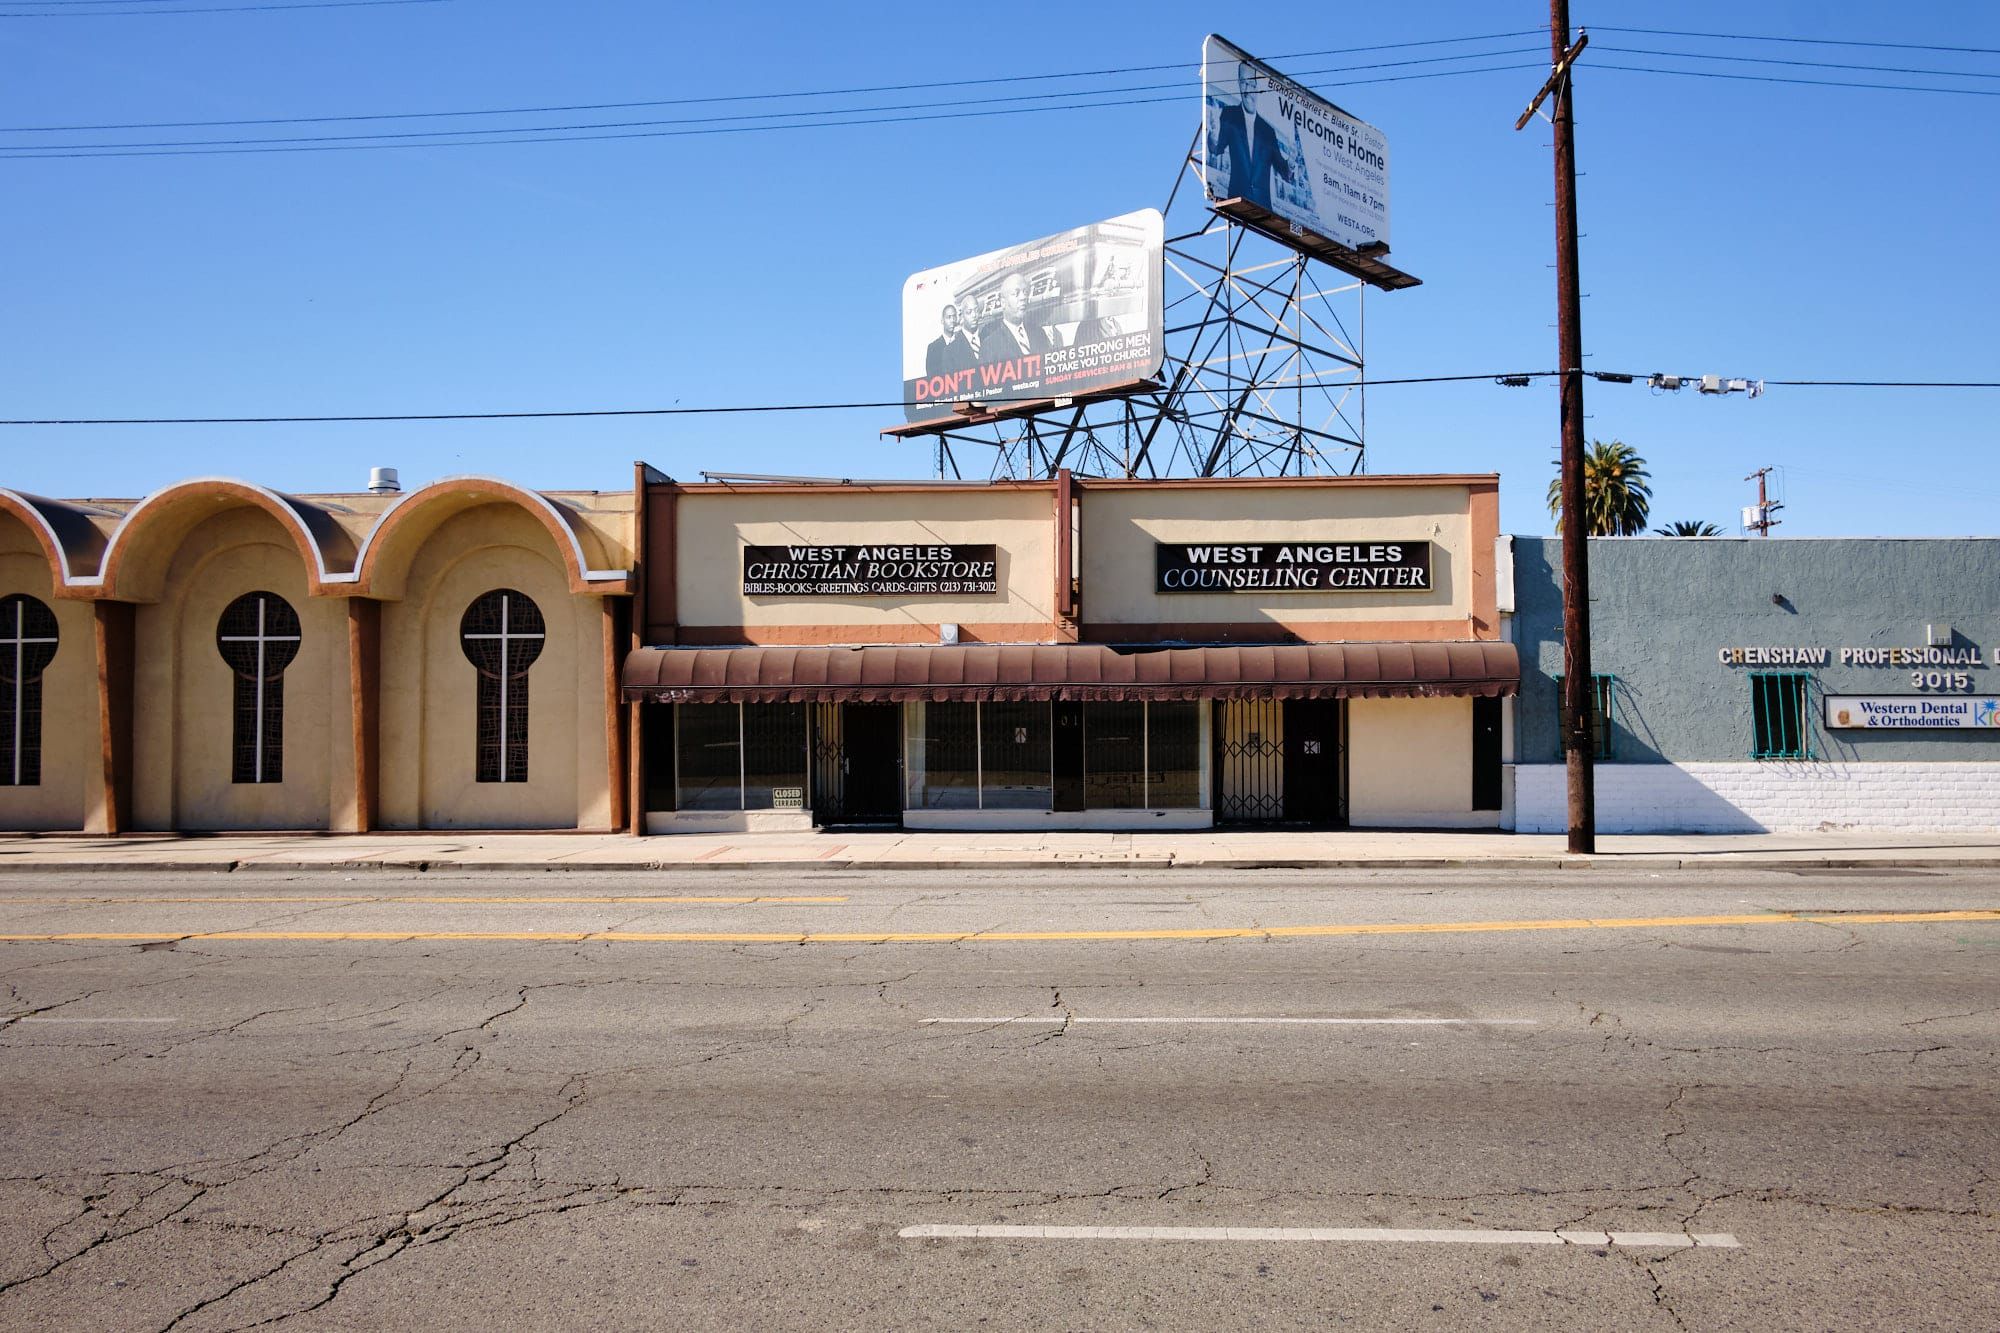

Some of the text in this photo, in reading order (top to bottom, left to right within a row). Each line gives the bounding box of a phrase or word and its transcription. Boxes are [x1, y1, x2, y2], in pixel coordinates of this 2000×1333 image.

[1268, 78, 1294, 100] Bishop
[1295, 94, 1321, 116] Charles
[1323, 110, 1330, 121] E.
[1331, 115, 1350, 132] Blake
[1364, 133, 1385, 152] Pastor
[1278, 97, 1385, 171] Welcome Home
[1323, 145, 1332, 158] to
[1333, 149, 1354, 170] West
[1354, 162, 1385, 186] Angeles
[1323, 173, 1342, 192] 8am,
[1343, 183, 1361, 201] 11am
[1362, 193, 1368, 204] &
[1369, 196, 1386, 213] 7pm
[1337, 212, 1376, 238] WESTA.ORG
[1044, 332, 1151, 365] FOR 6 STRONG MEN
[1044, 345, 1152, 376] TO TAKE YOU TO CHURCH
[915, 354, 1041, 401] DON'T WAIT!
[1045, 374, 1072, 385] SUNDAY
[1073, 366, 1109, 380] SERVICES:
[985, 387, 1003, 396] Pastor
[1012, 380, 1040, 391] westa.org
[789, 546, 953, 562] WEST ANGELES
[1187, 545, 1403, 564] WEST ANGELES
[747, 561, 994, 580] CHRISTIAN BOOKSTORE
[1164, 566, 1427, 588] COUNSELING CENTER
[744, 581, 997, 594] BIBLES-BOOKS-GREETINGS CARDS-GIFTS (213) 731-3012
[1718, 647, 1826, 665] CRENSHAW
[1840, 647, 1982, 665] PROFESSIONAL
[1911, 671, 1968, 689] 3015
[1860, 702, 1968, 714] Western Dental
[1868, 715, 1961, 726] & Orthodontics
[774, 799, 802, 807] CERRADO
[775, 789, 801, 798] CLOSED
